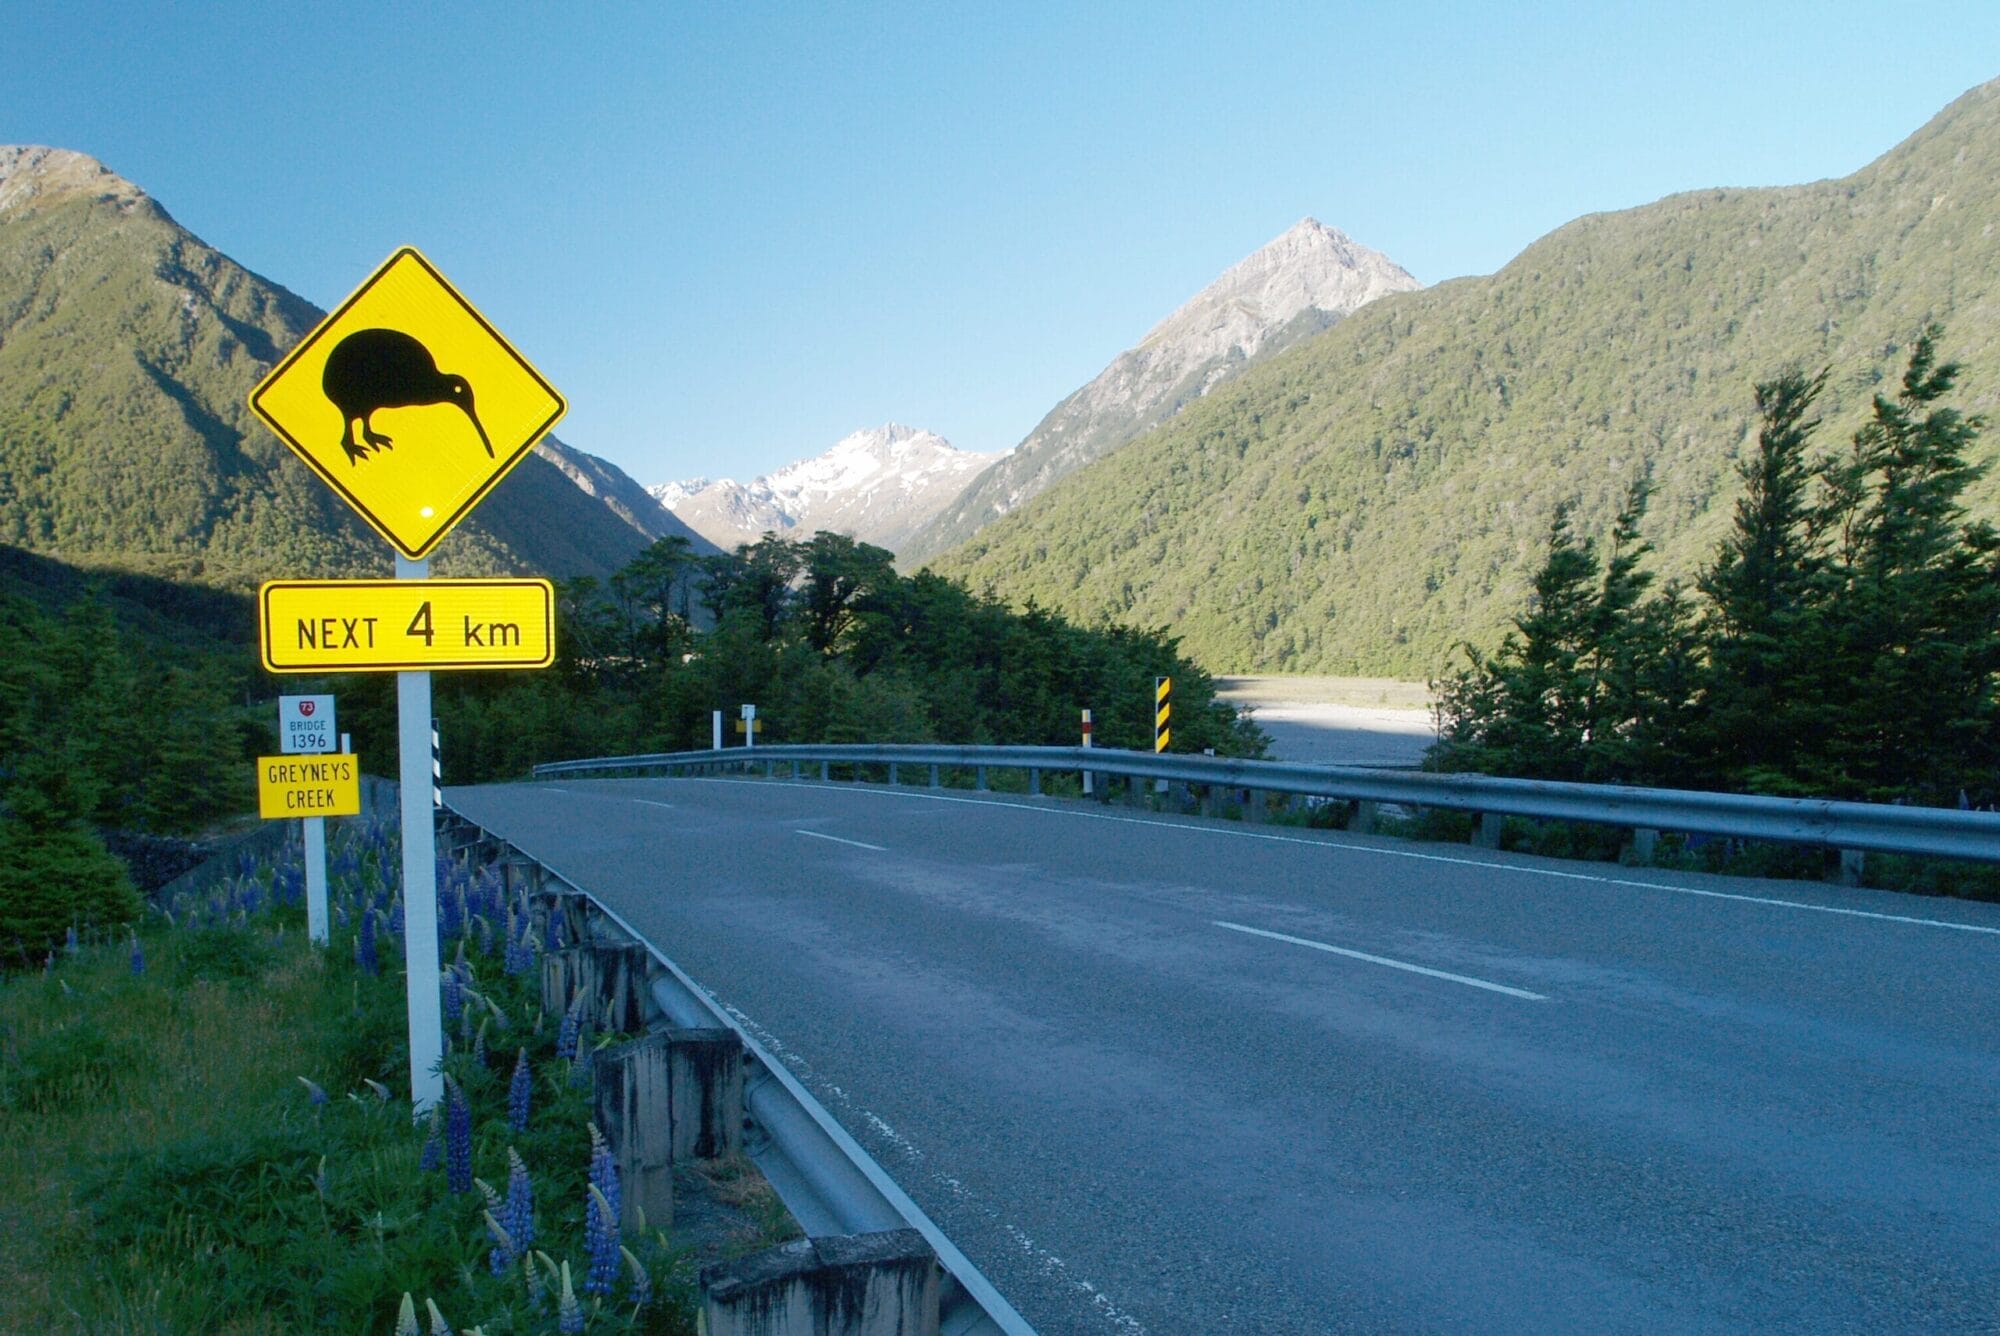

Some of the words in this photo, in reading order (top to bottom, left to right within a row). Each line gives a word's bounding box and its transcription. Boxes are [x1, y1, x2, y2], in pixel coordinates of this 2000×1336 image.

[298, 618, 378, 649] NEXT
[406, 601, 434, 647] 4
[464, 615, 520, 647] km
[301, 703, 313, 712] 73
[290, 720, 326, 731] BRIDGE
[292, 734, 326, 748] 1396
[269, 763, 350, 783] GREYNEYS
[287, 789, 335, 808] CREEK
